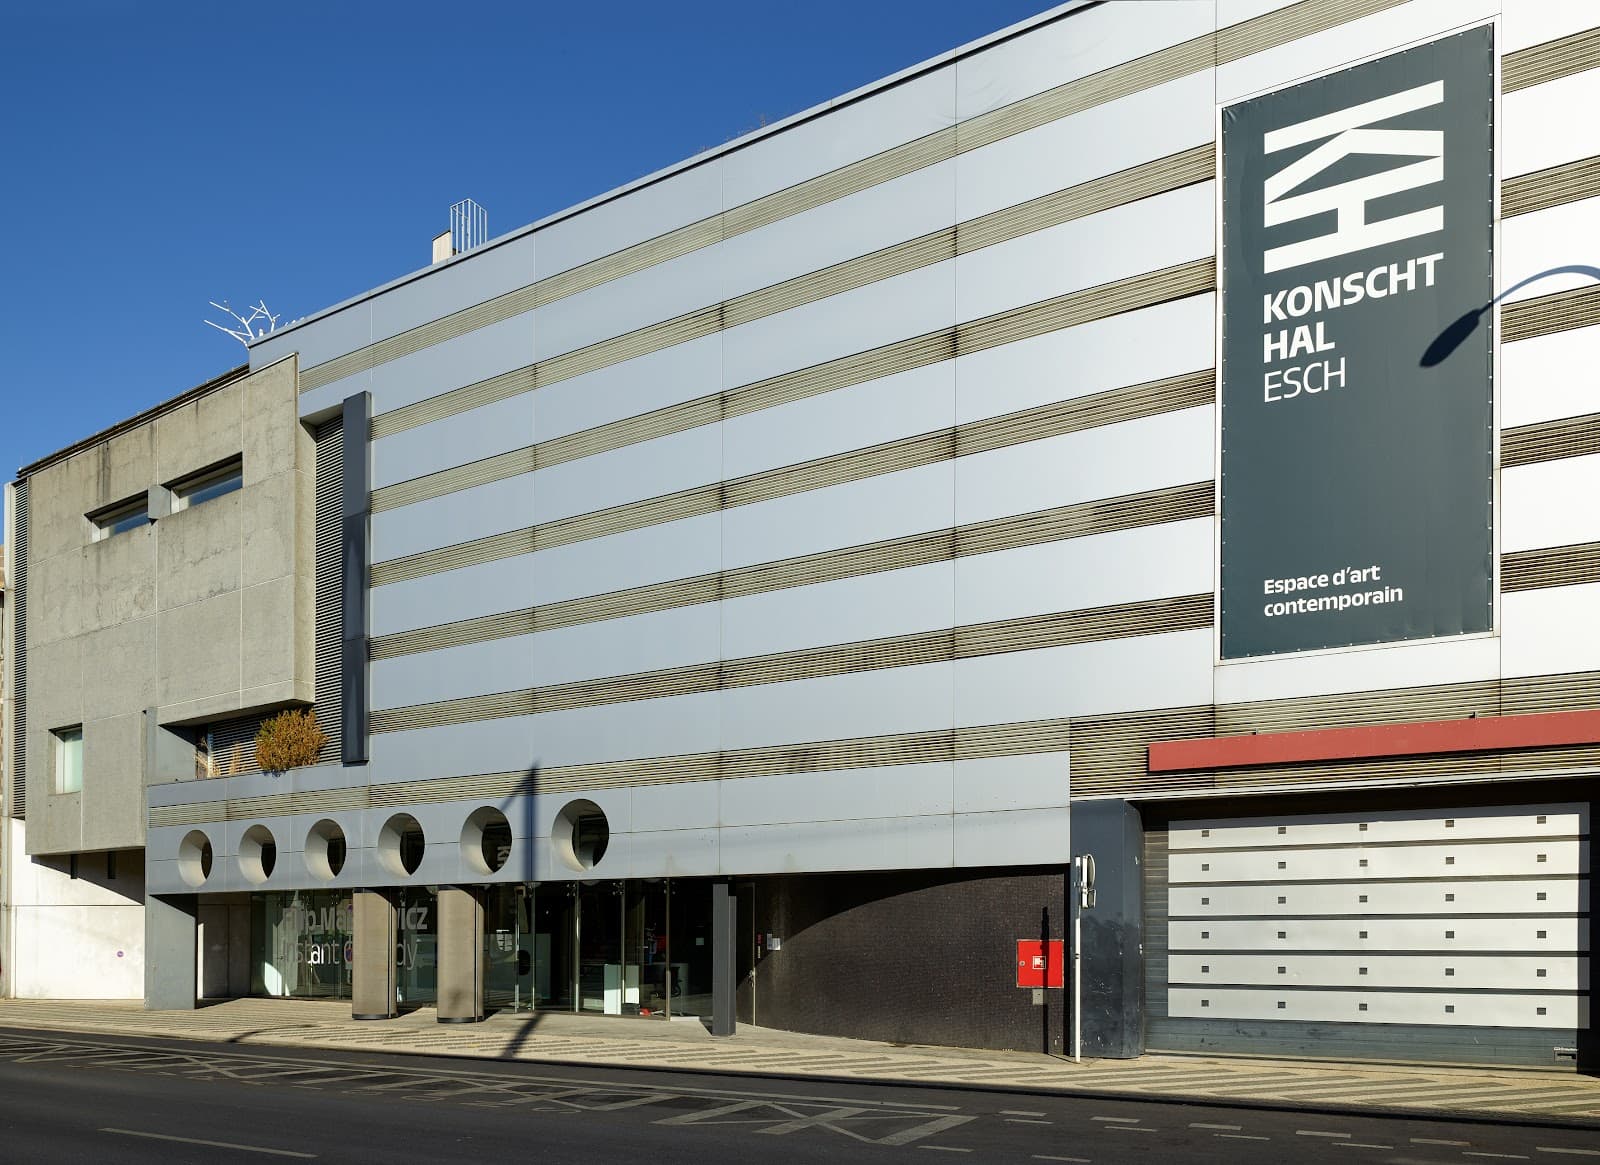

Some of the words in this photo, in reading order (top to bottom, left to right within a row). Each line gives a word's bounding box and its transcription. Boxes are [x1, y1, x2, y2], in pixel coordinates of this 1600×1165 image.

[1263, 252, 1444, 324] KONSCHT
[1263, 321, 1335, 364] HAL
[1263, 357, 1346, 403] ESCH
[1264, 572, 1329, 595] Espace
[1332, 565, 1381, 587] d'art
[1264, 586, 1403, 617] contemporain
